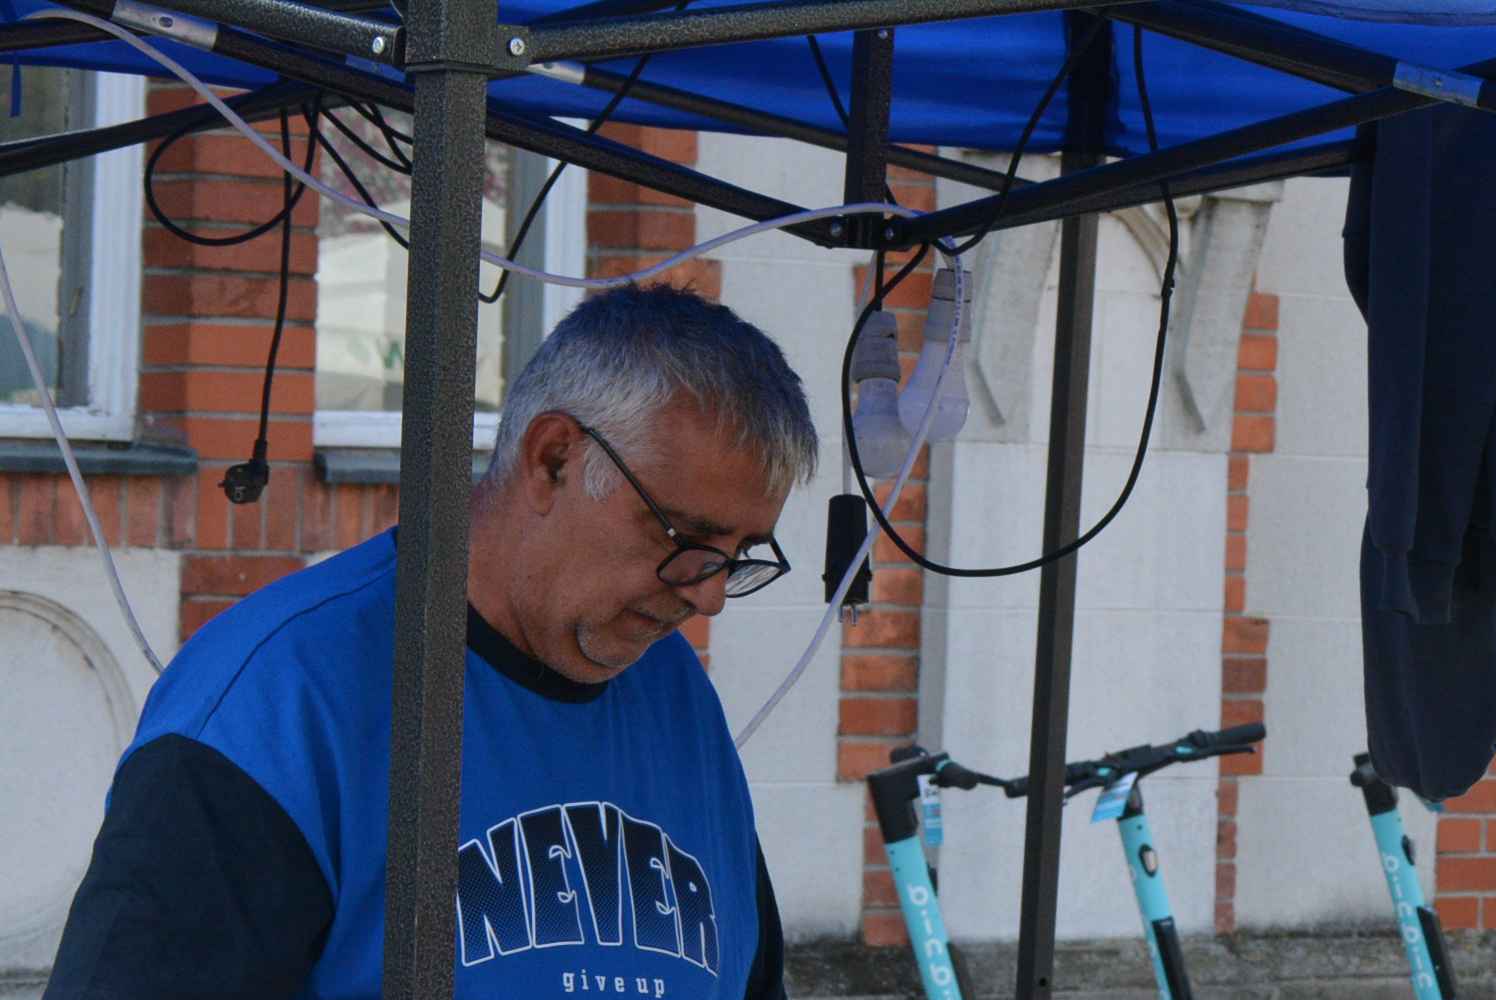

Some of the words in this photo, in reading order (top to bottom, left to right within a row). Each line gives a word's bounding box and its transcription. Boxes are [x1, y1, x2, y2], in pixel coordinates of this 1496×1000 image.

[456, 801, 720, 977] NEVER
[562, 968, 625, 993] give
[635, 977, 665, 998] up
